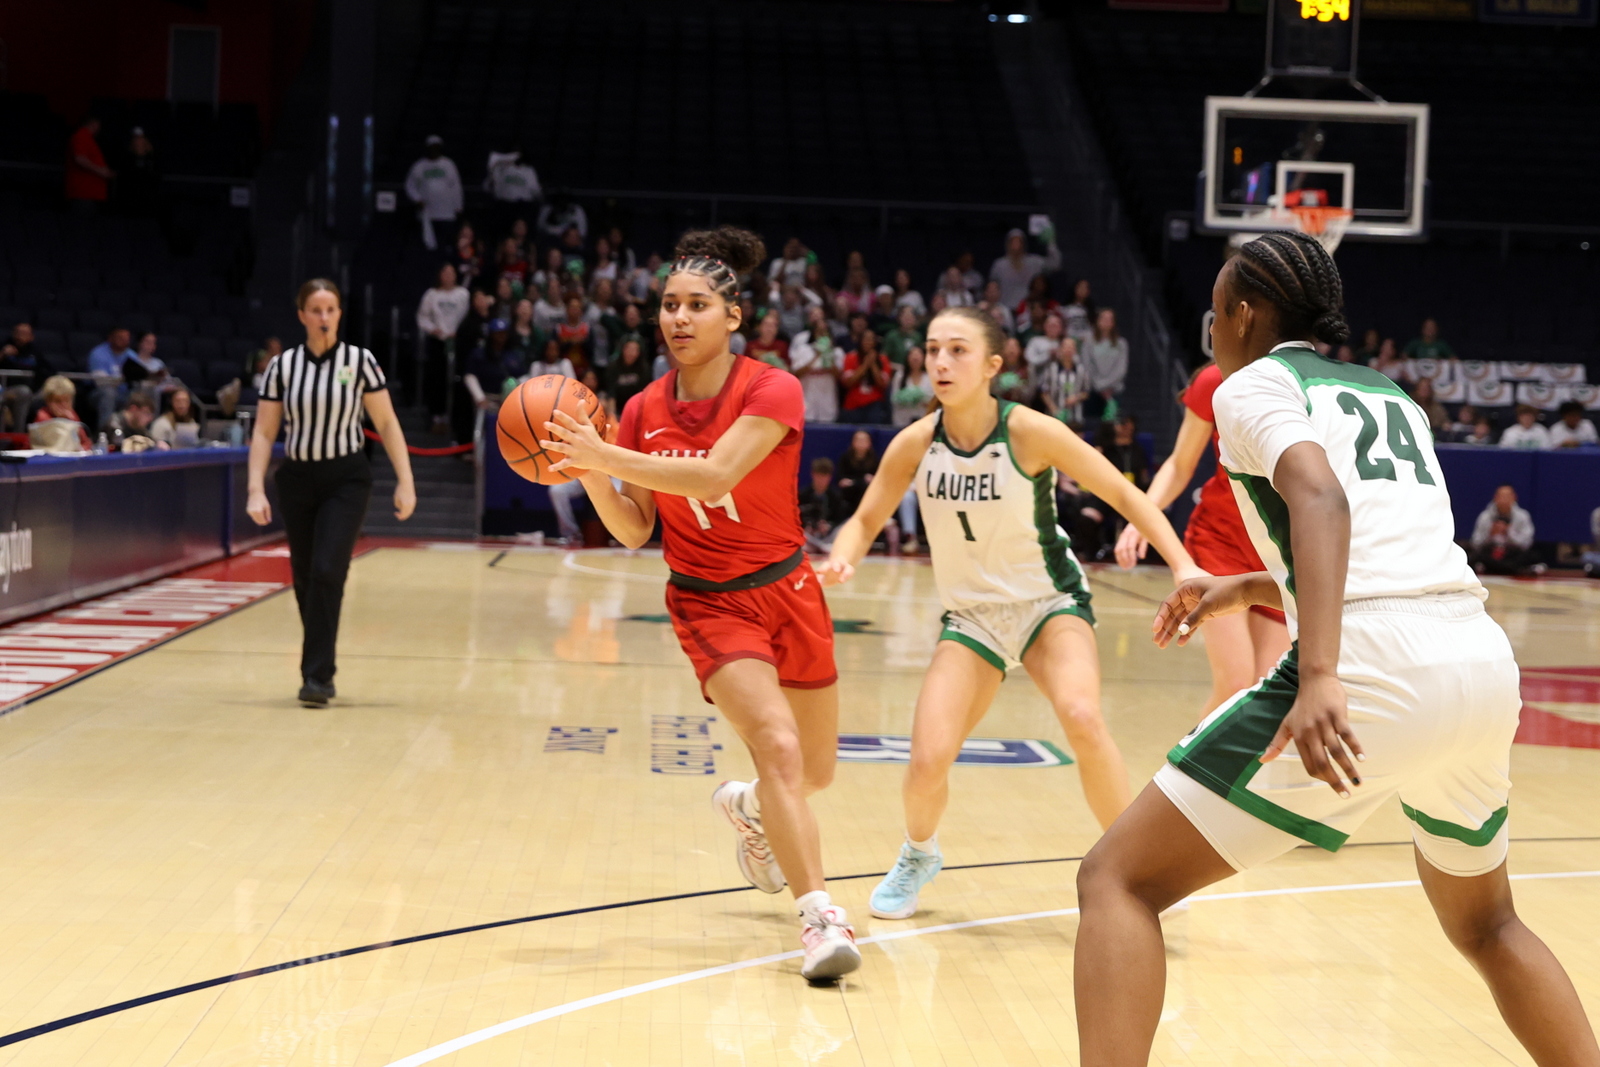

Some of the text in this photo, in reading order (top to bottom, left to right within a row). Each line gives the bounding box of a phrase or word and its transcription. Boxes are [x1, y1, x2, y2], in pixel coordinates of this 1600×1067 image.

[1336, 391, 1436, 486] 24
[927, 470, 1002, 501] LAUREL
[956, 511, 977, 542] 1
